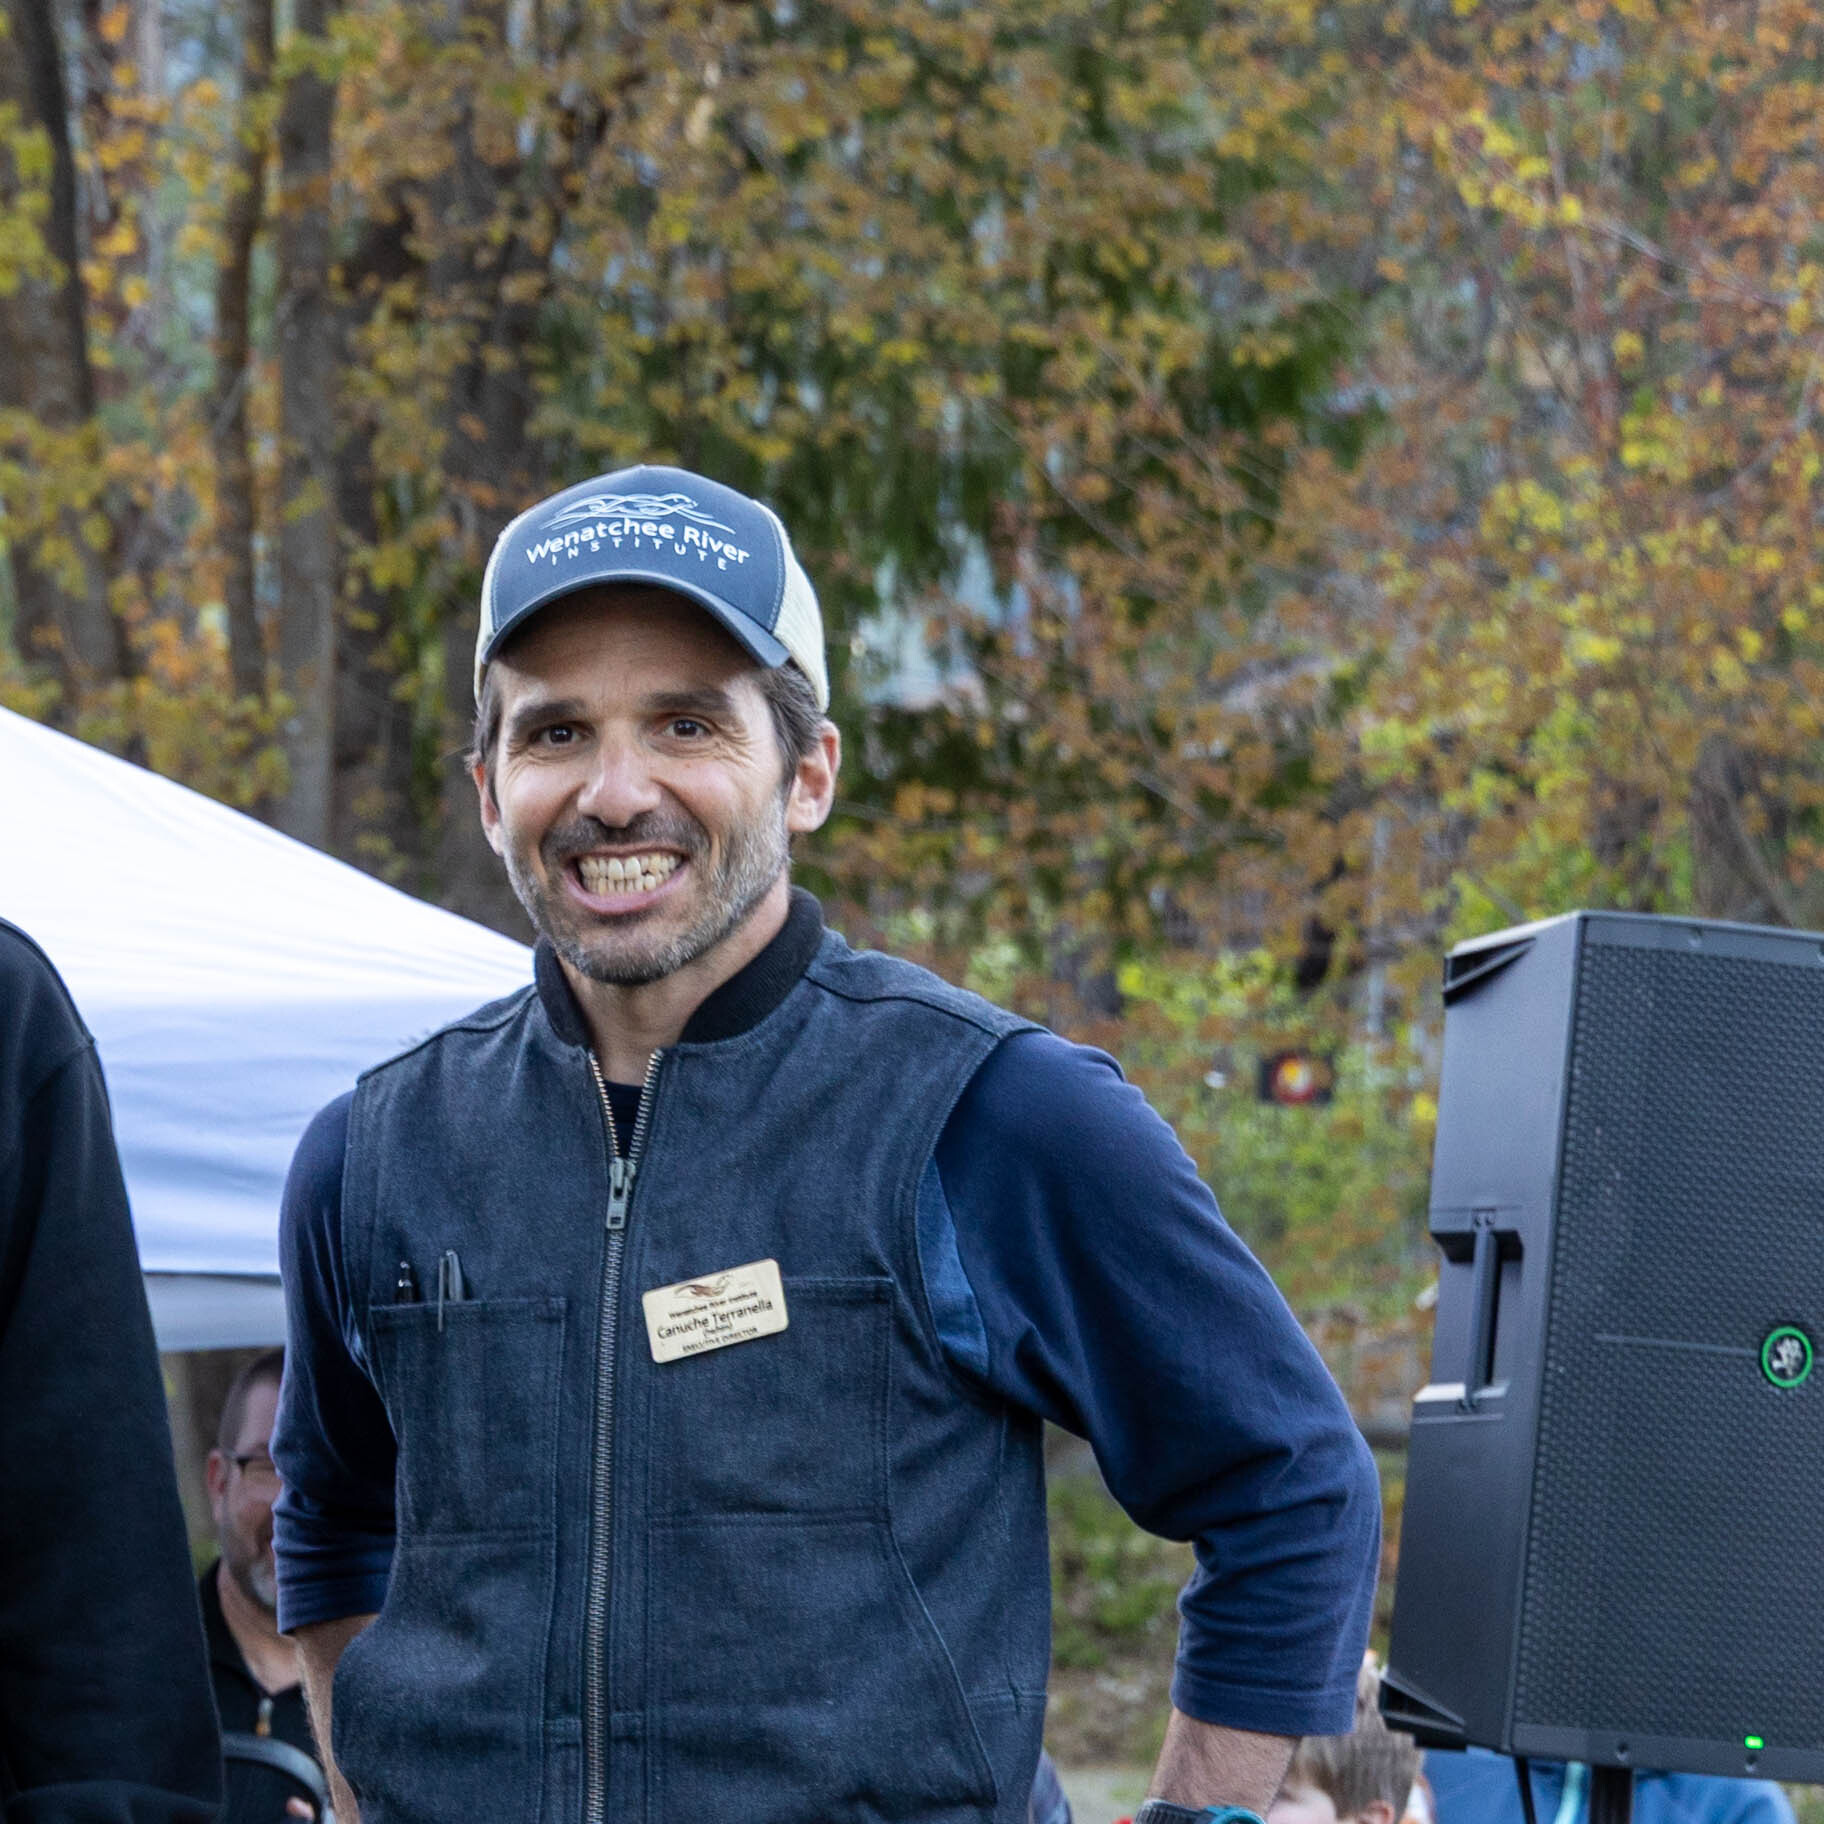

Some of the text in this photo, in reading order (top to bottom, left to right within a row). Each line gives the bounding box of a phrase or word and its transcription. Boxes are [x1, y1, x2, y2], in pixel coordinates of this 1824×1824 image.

[526, 518, 750, 566] Wenatchee River
[551, 537, 728, 571] INSTITUTE
[657, 1317, 710, 1340] Canuche
